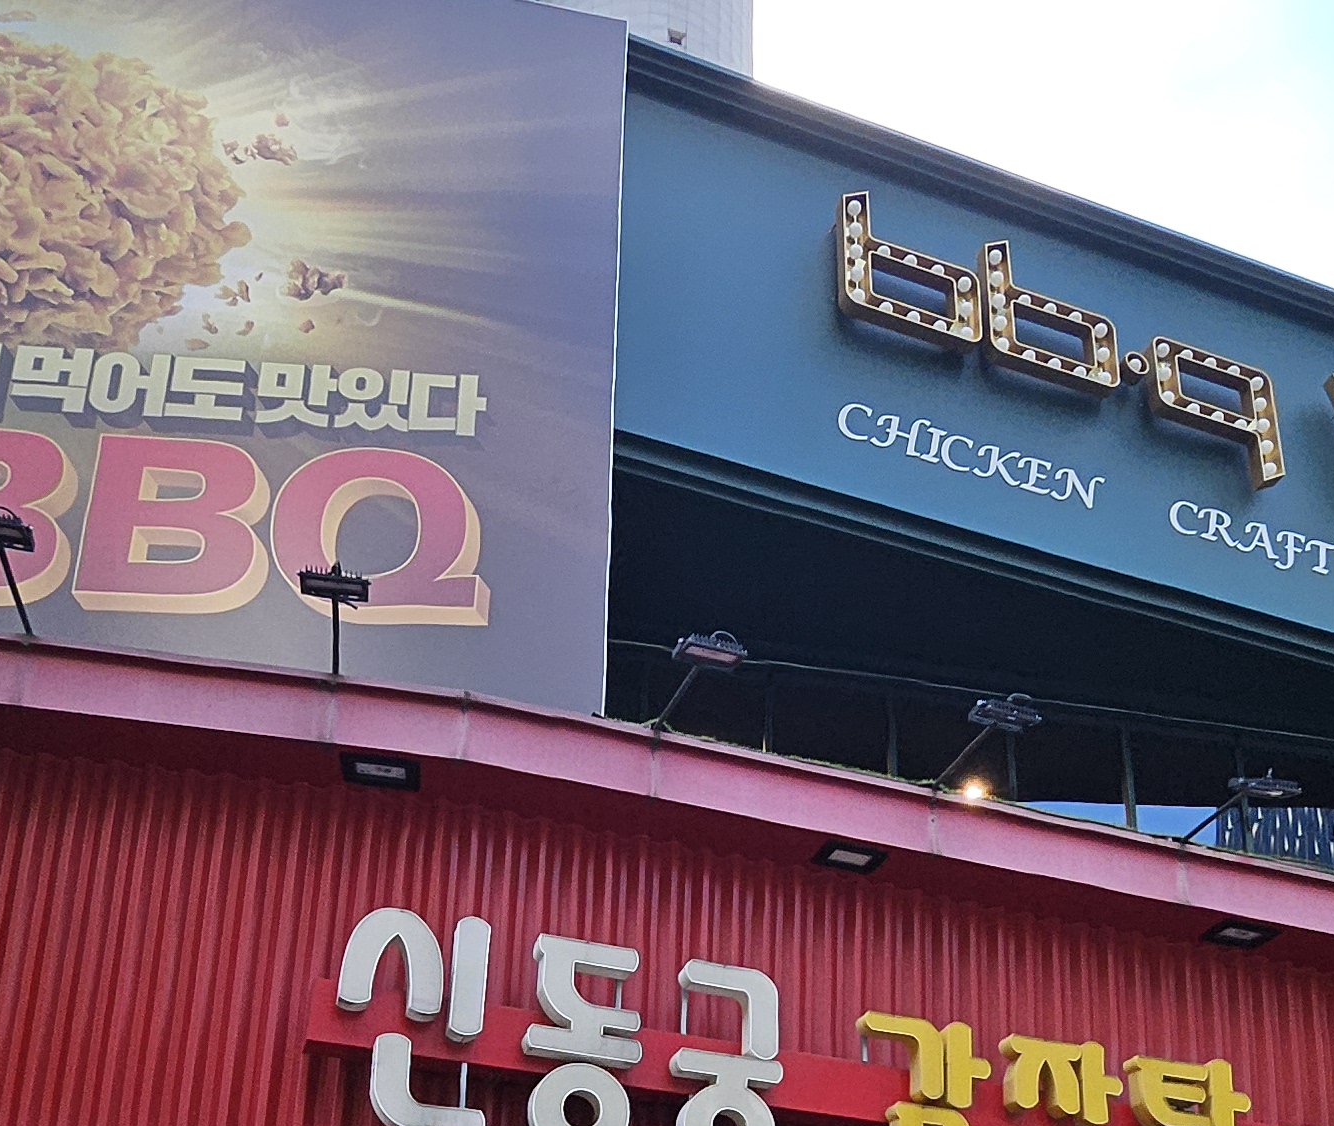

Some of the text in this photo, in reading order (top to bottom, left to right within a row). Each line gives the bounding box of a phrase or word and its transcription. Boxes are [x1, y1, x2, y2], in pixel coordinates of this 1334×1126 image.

[9, 345, 247, 425] 먹어도
[255, 362, 488, 438] 맛있다
[838, 400, 1105, 511] CHICKEN
